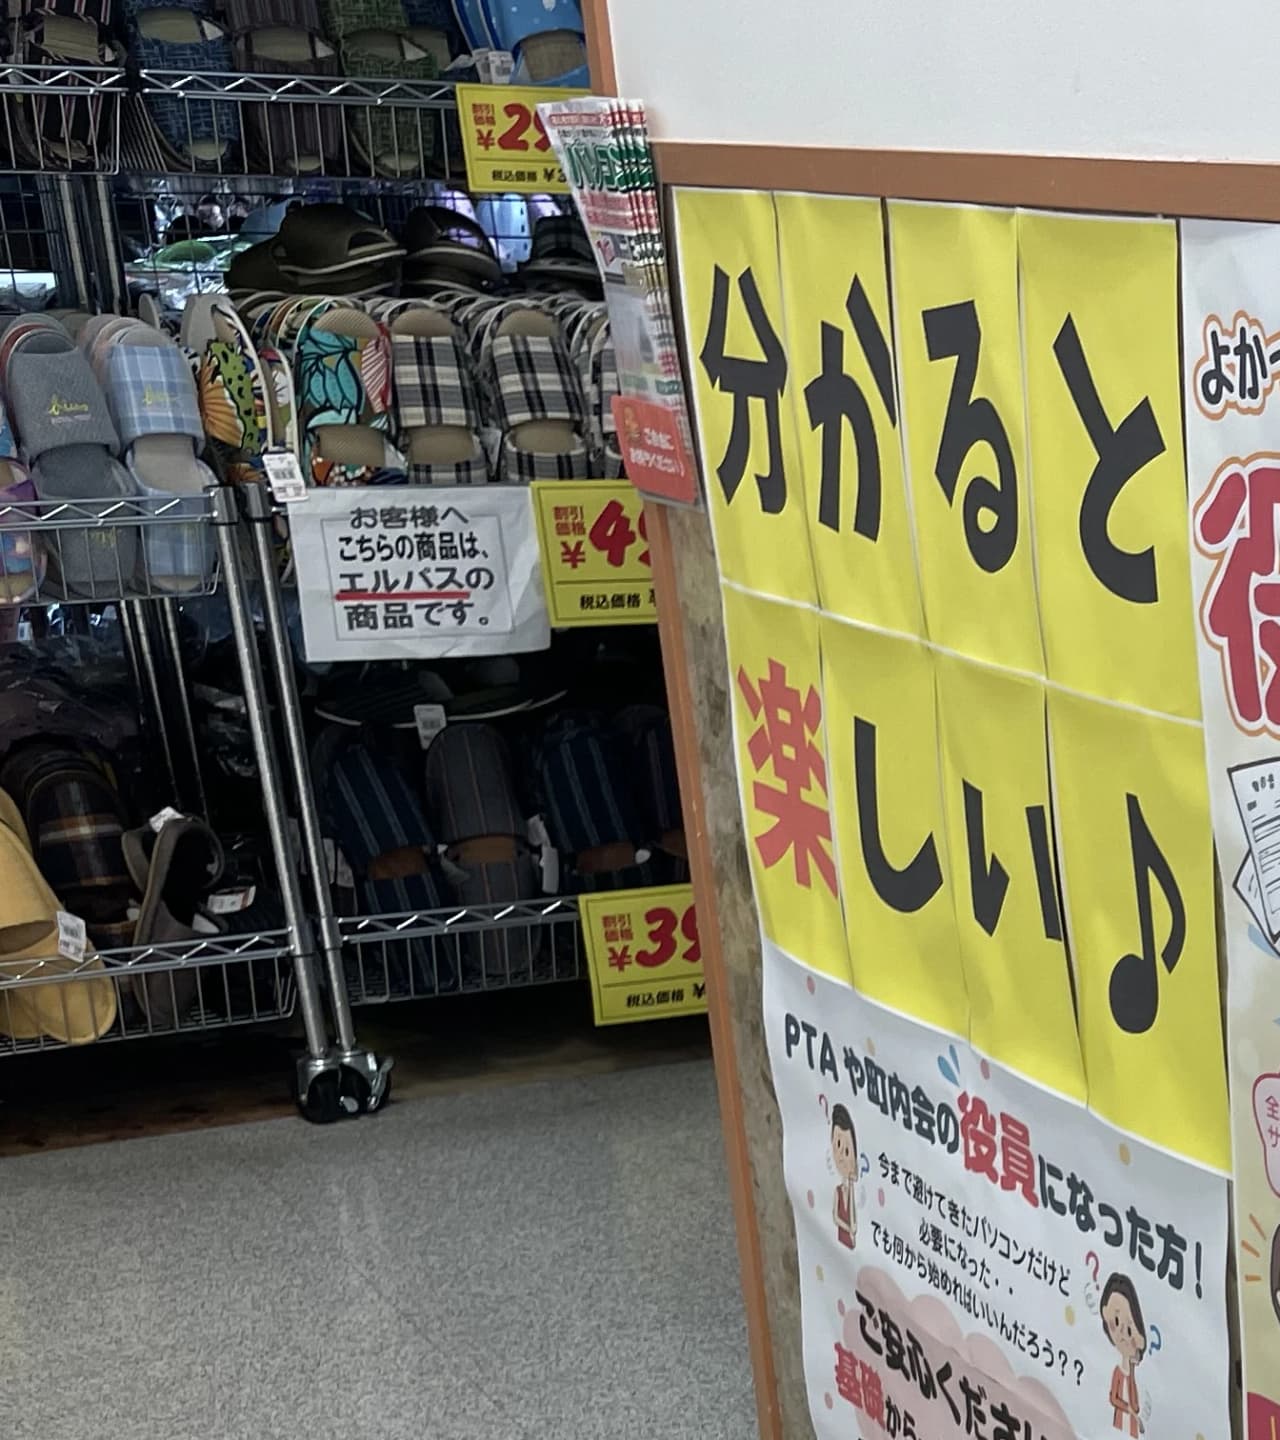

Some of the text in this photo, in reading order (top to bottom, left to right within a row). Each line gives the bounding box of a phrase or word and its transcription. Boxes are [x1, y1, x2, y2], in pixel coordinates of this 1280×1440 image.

[350, 505, 469, 529] お客様へ
[338, 531, 488, 562] こちらの商品は、
[344, 600, 489, 631] 商品です。
[579, 592, 641, 612] 税込価格
